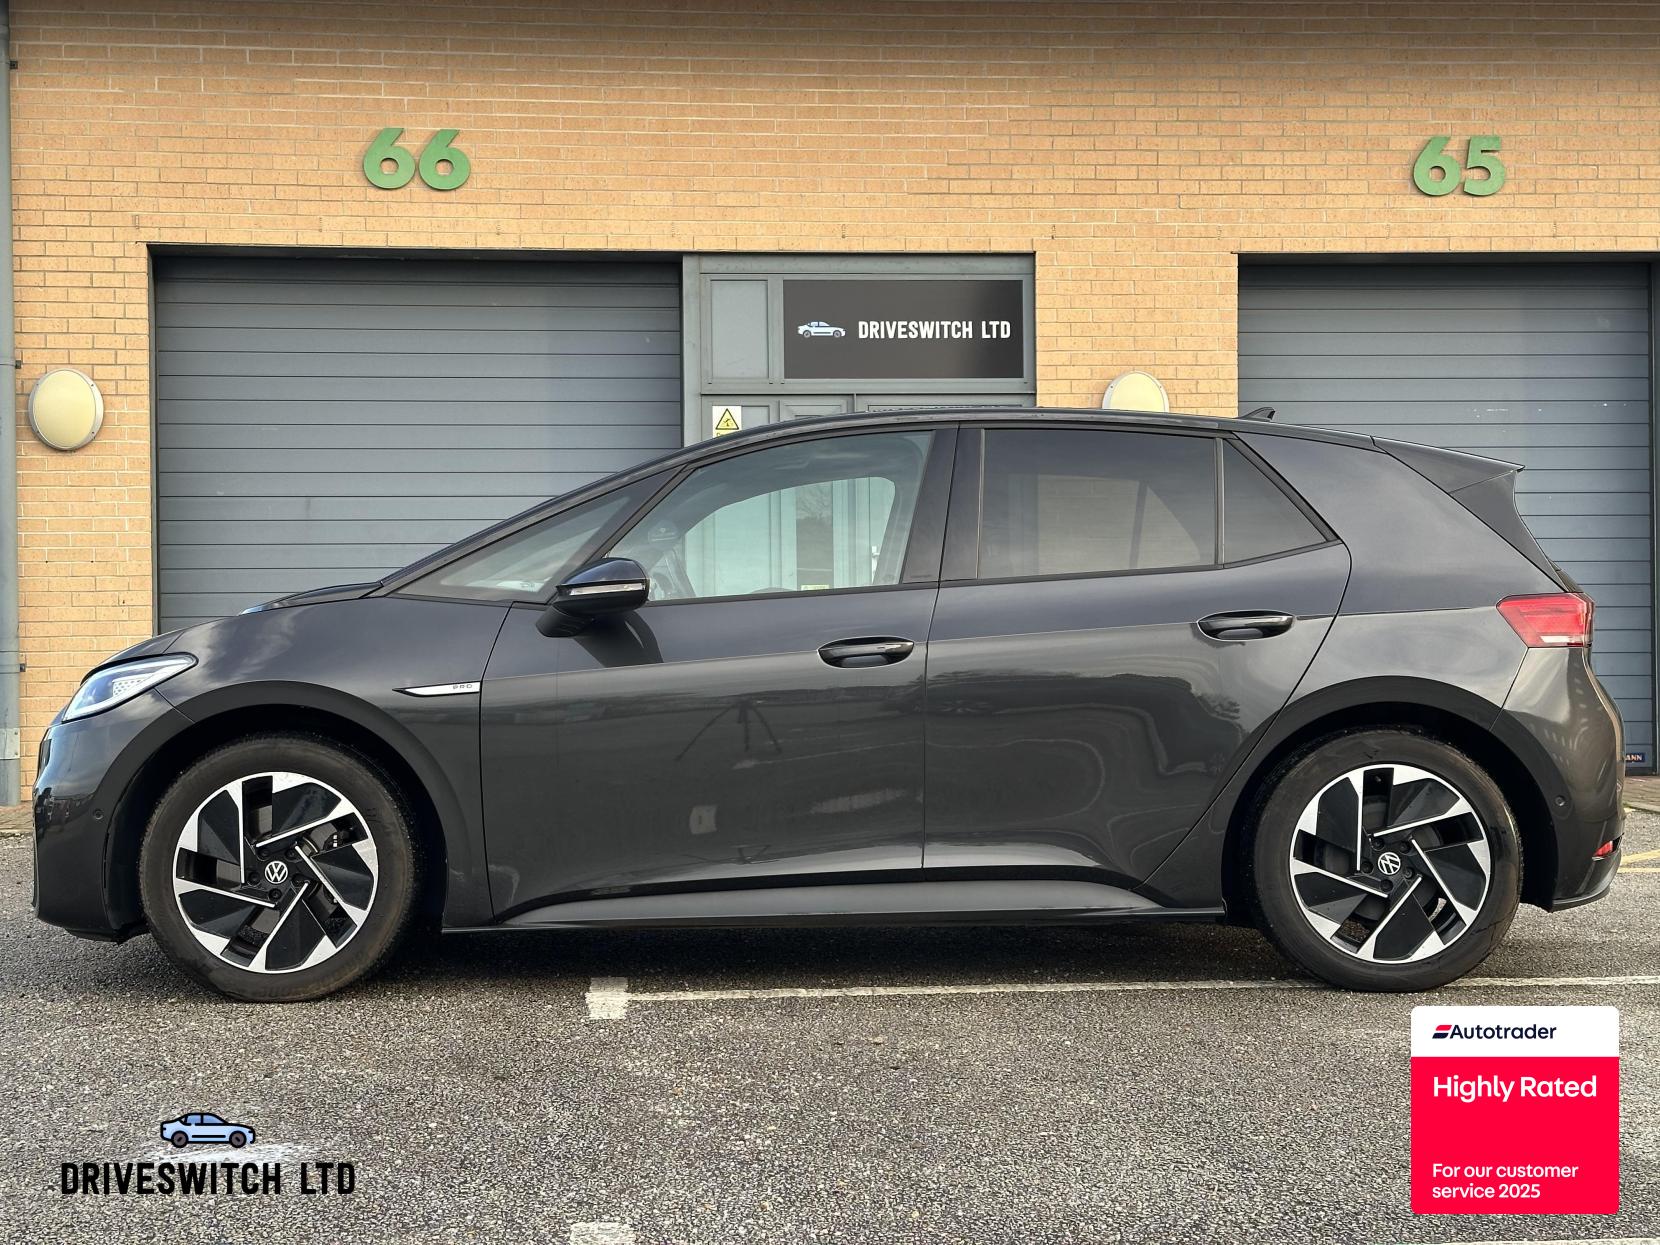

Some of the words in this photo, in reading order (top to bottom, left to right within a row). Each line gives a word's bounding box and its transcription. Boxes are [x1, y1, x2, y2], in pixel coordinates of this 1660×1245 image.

[363, 128, 471, 190] 66
[1413, 136, 1506, 196] 65
[858, 320, 973, 340] DRIVESWITCH
[981, 320, 1011, 340] LTD
